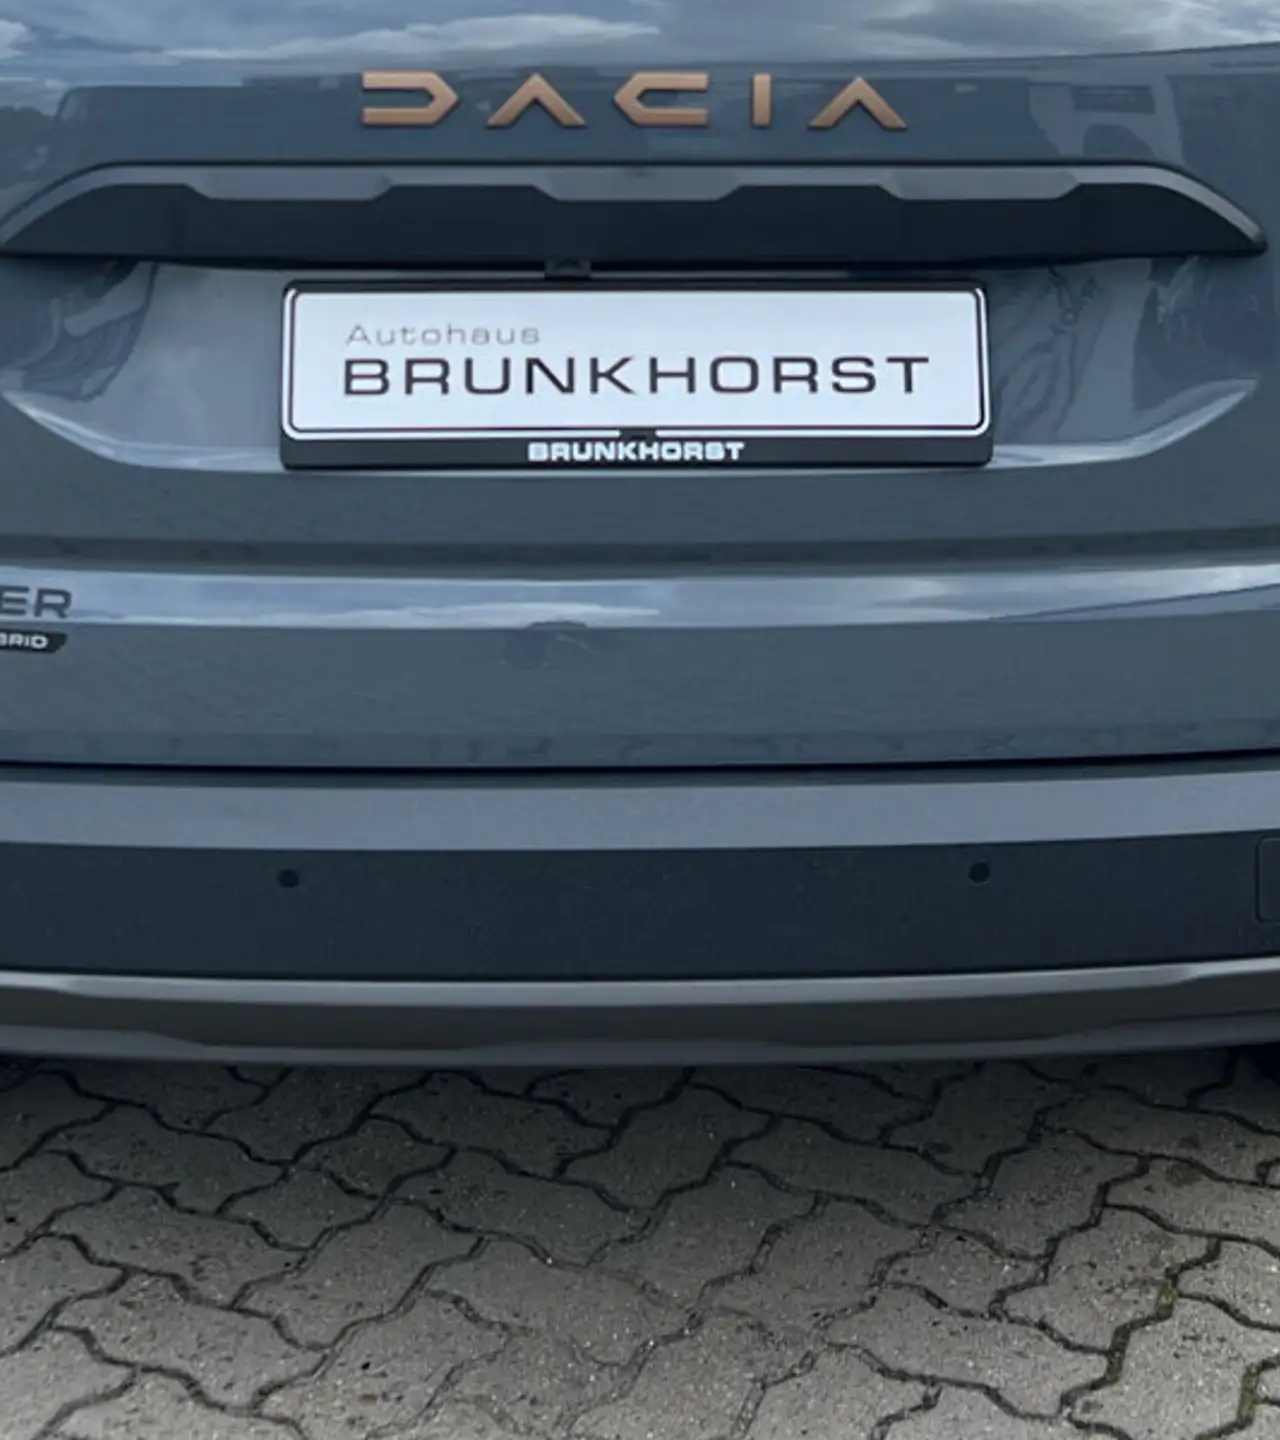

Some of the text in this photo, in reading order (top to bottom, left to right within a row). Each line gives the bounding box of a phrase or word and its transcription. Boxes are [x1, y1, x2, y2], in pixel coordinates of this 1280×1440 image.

[361, 71, 908, 130] DACIA
[344, 323, 542, 346] Autohaus
[343, 356, 930, 396] BRUNKHORST
[527, 440, 746, 462] BRUNKHORST
